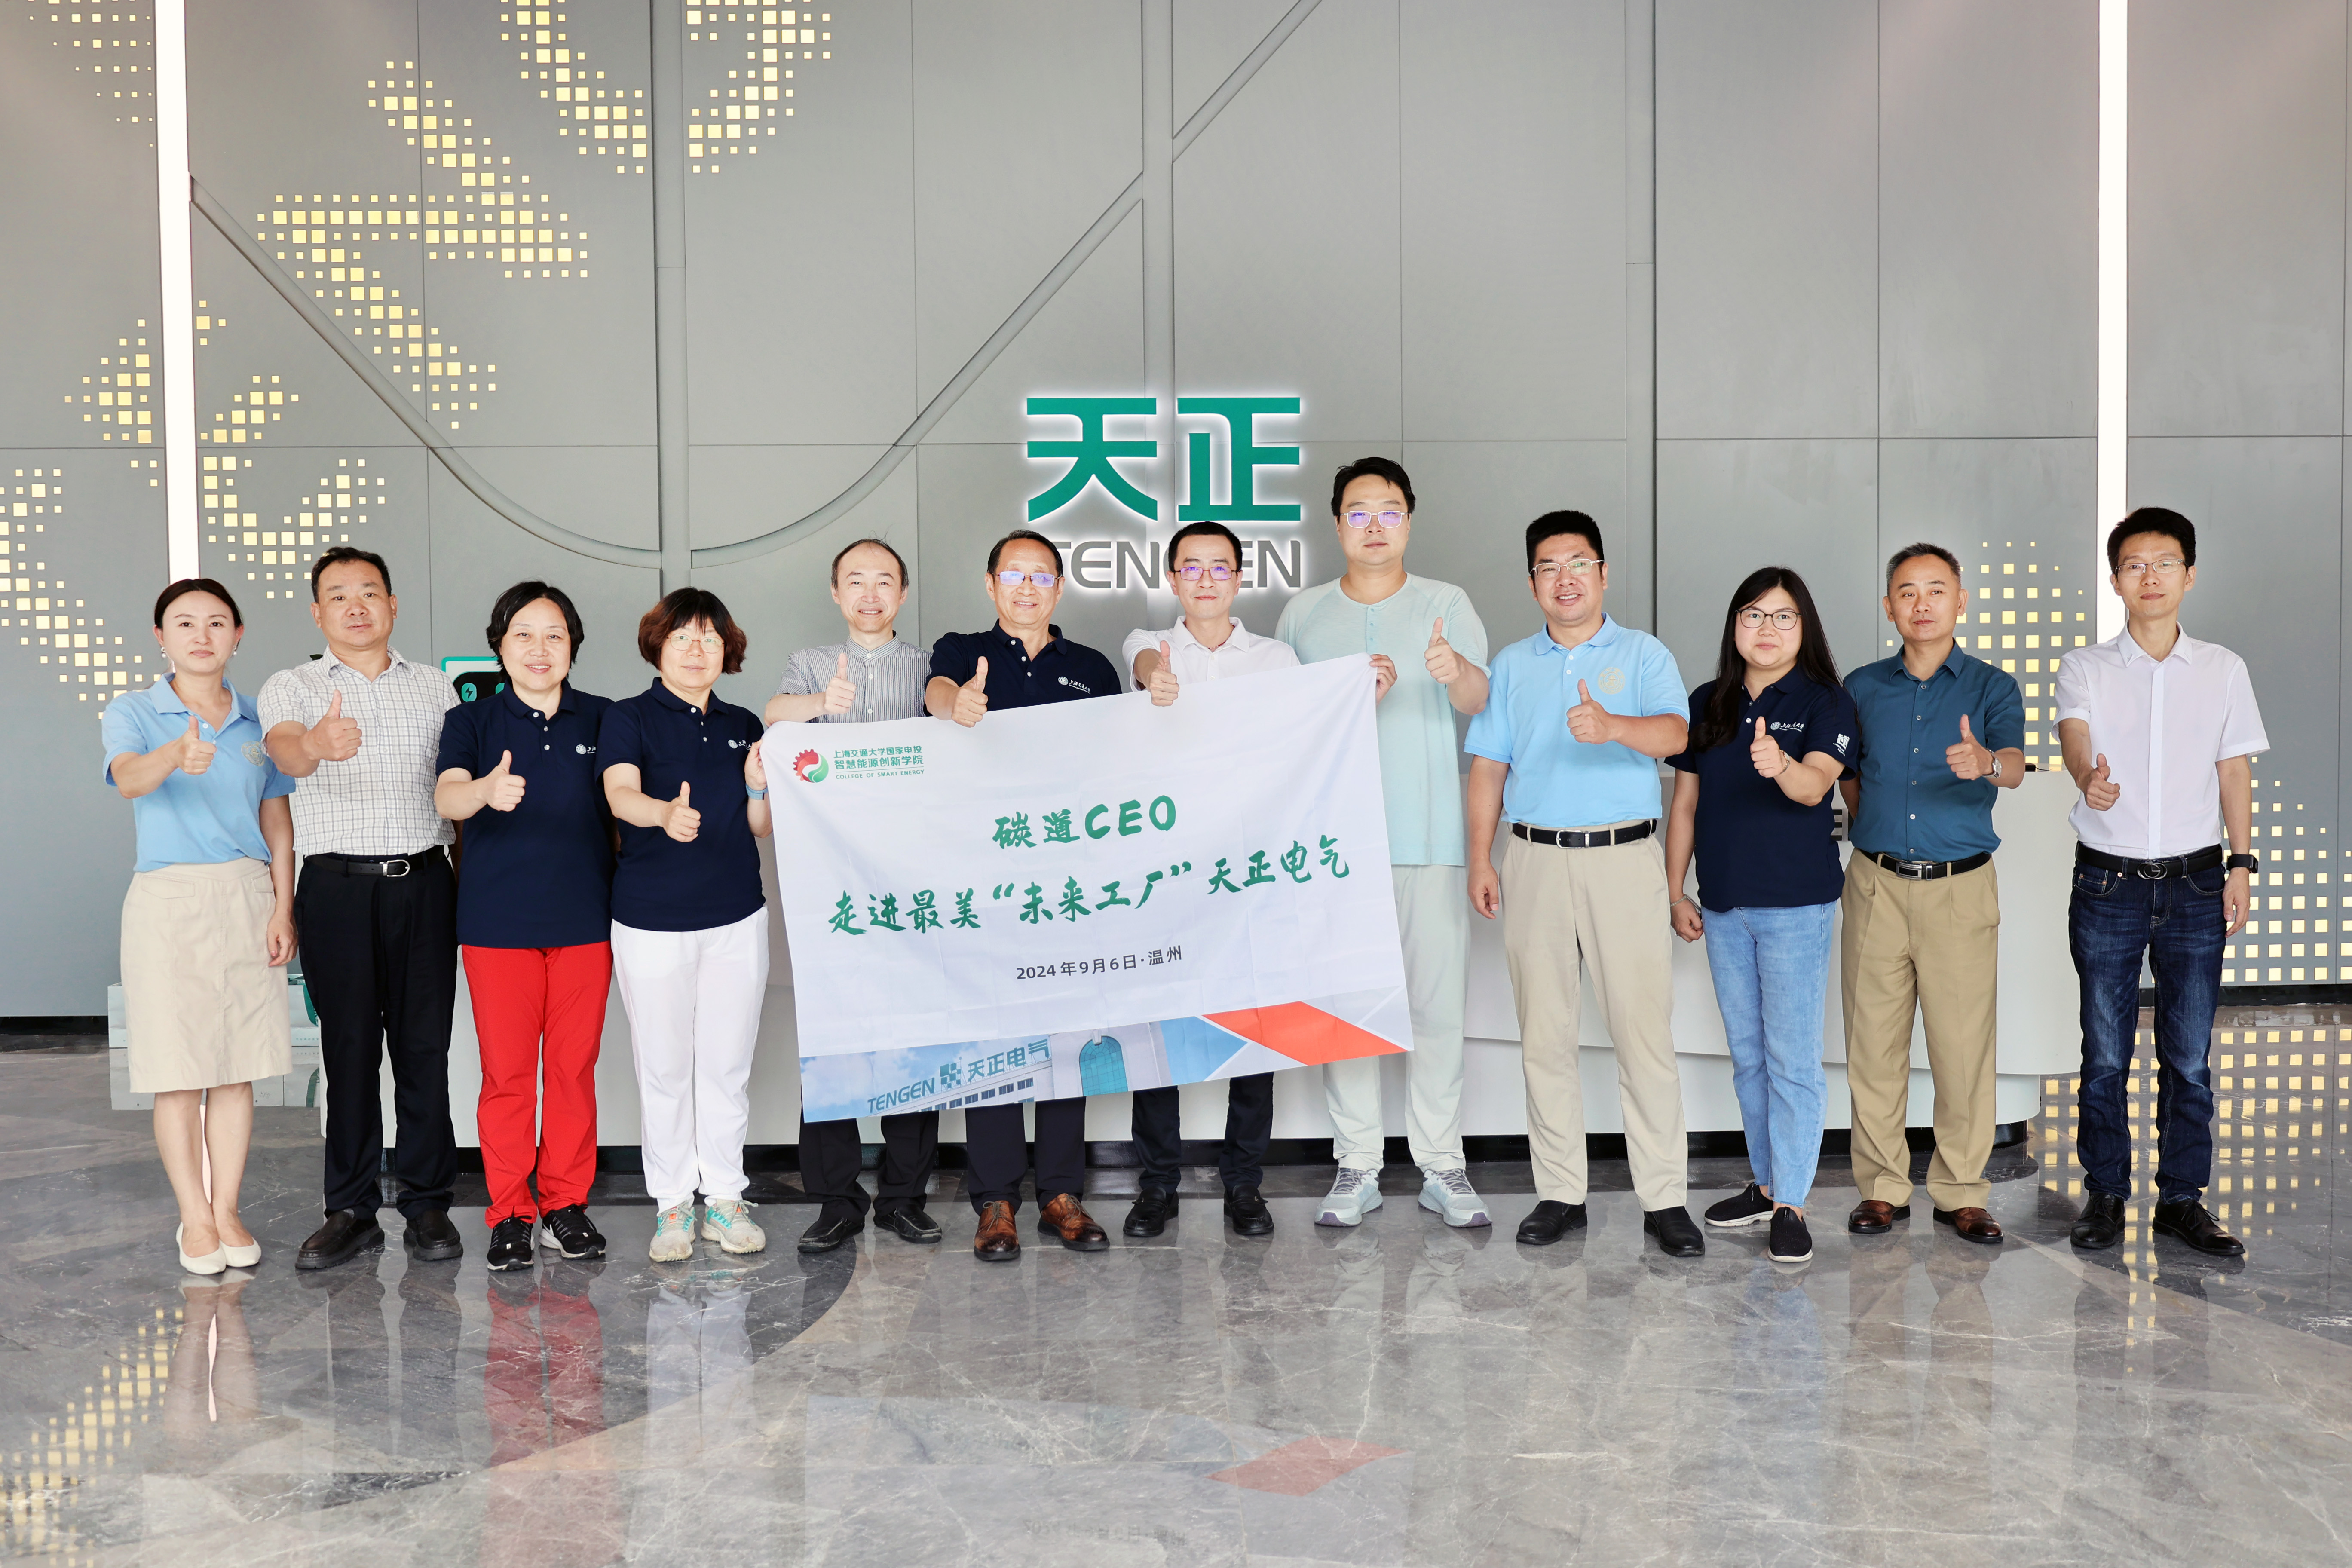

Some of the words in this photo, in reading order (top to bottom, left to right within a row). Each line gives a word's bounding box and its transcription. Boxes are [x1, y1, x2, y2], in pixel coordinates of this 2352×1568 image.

[1027, 398, 1301, 522] 天正
[834, 746, 922, 758] 上海交通大学国家电投
[834, 755, 924, 769] 智慧能源创新学院
[993, 795, 1176, 849] 碳道CEO
[968, 1039, 1049, 1082] 天正电气
[867, 1077, 935, 1113] TENGEN
